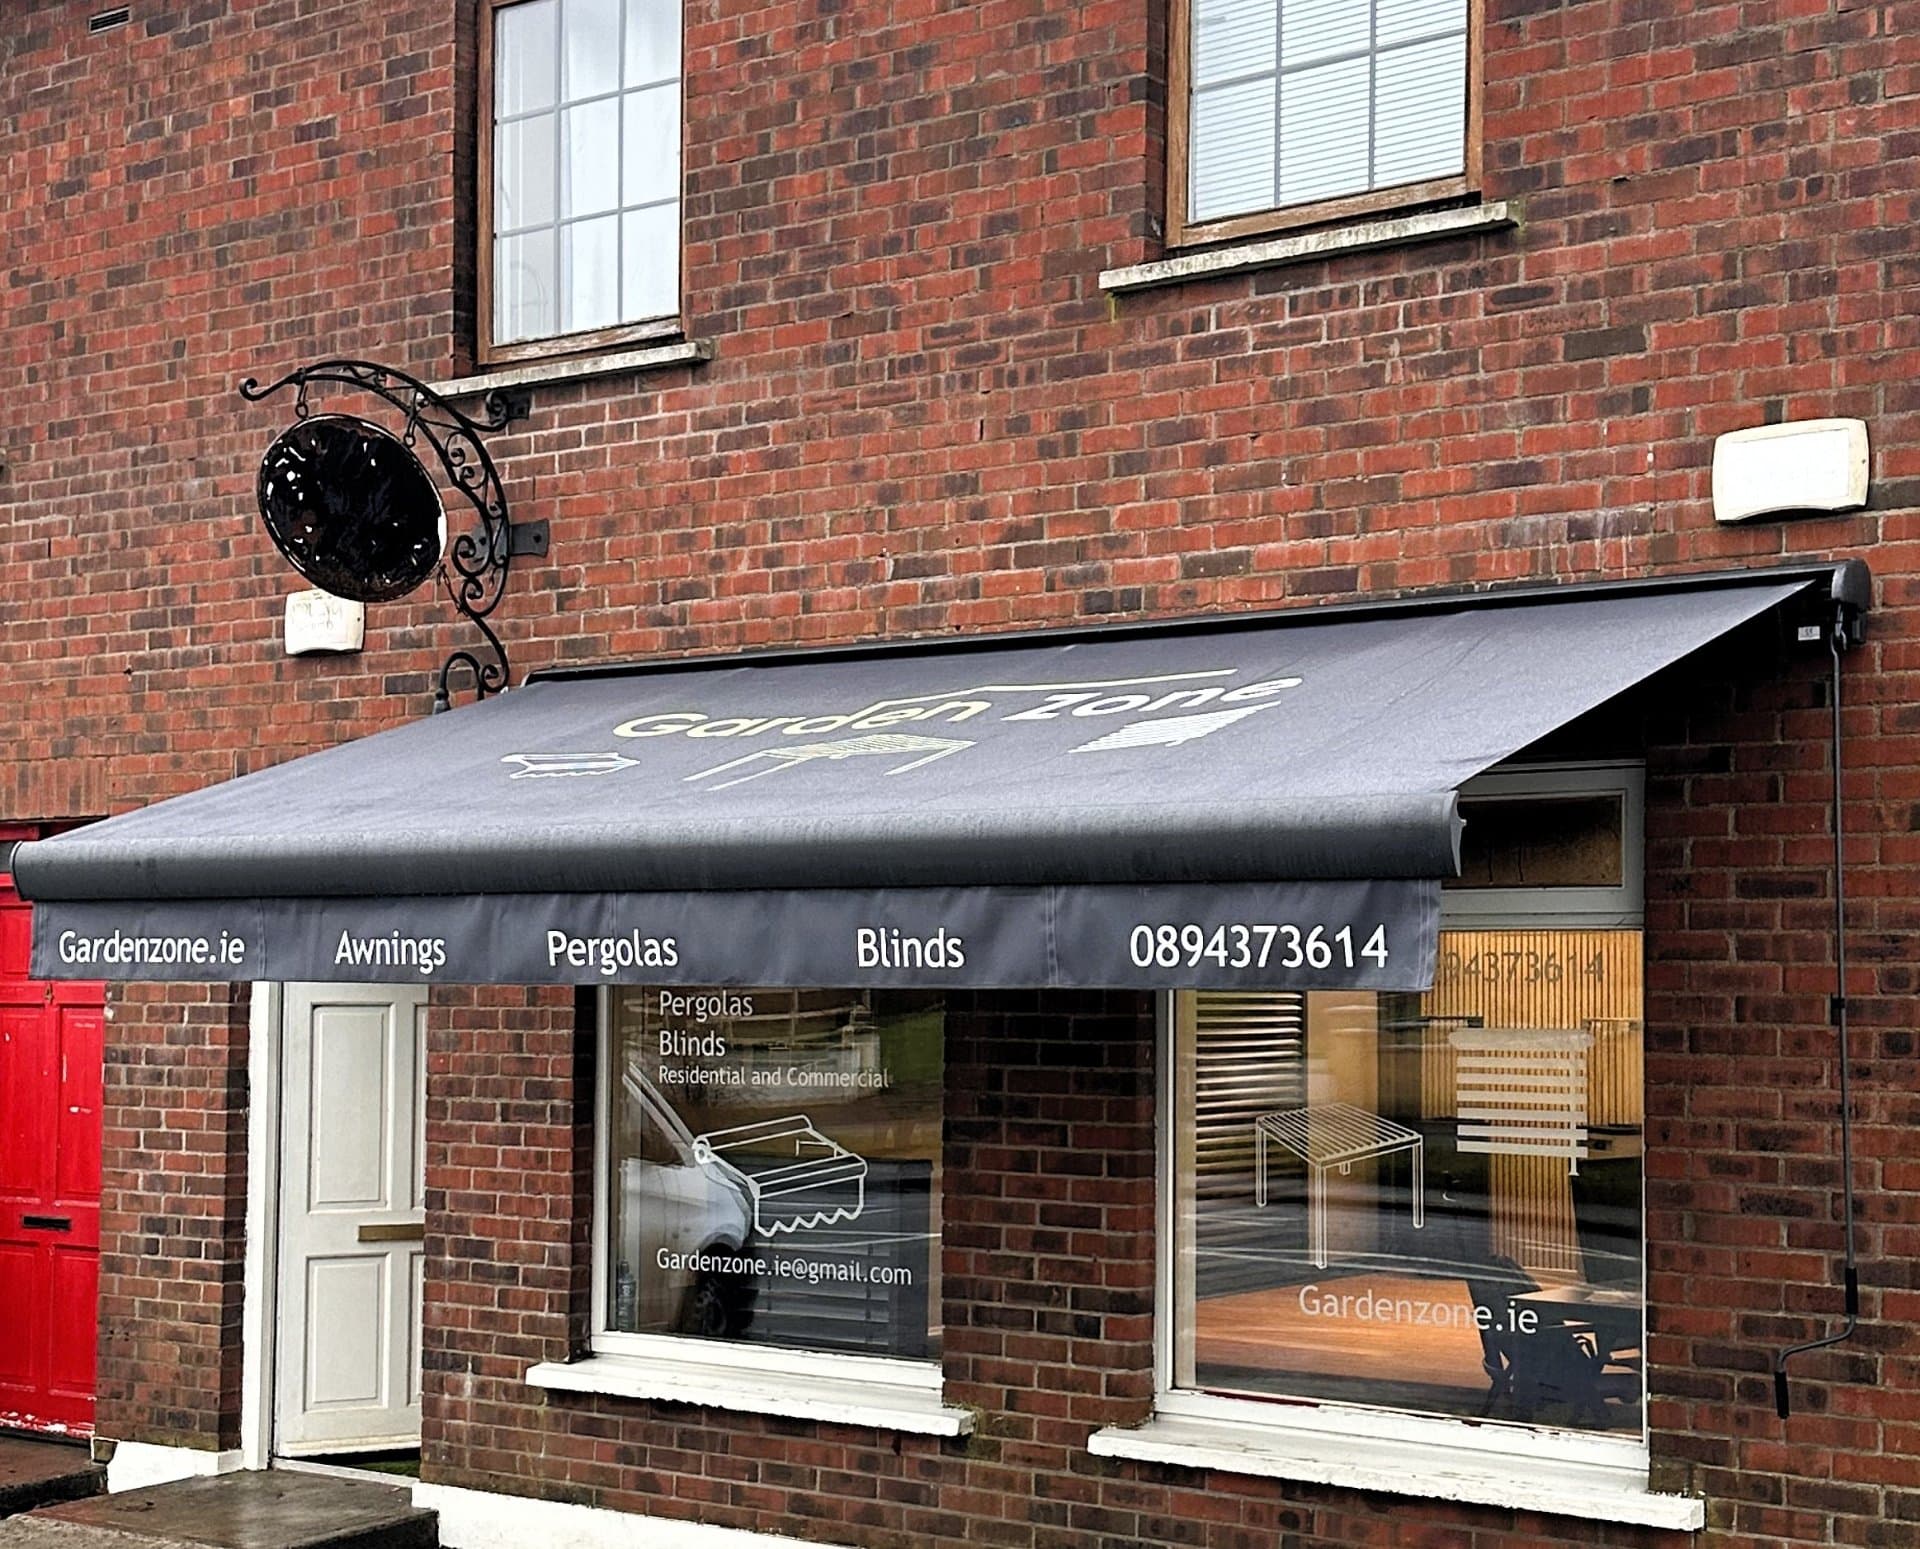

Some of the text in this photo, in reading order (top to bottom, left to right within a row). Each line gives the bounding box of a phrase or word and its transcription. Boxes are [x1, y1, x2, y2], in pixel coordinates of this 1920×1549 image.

[613, 699, 992, 738] Garden
[58, 924, 1389, 977] Gardenzone.ie Awnings Pergolas Blinds 0894373614
[659, 989, 754, 1023] Pergolas
[659, 1030, 726, 1057] Blinds
[659, 1065, 890, 1088] Residential and Commercial
[656, 1247, 913, 1285] Gardenzone.ie@gmail.com
[1298, 1284, 1540, 1334] Gardenzone.ie
